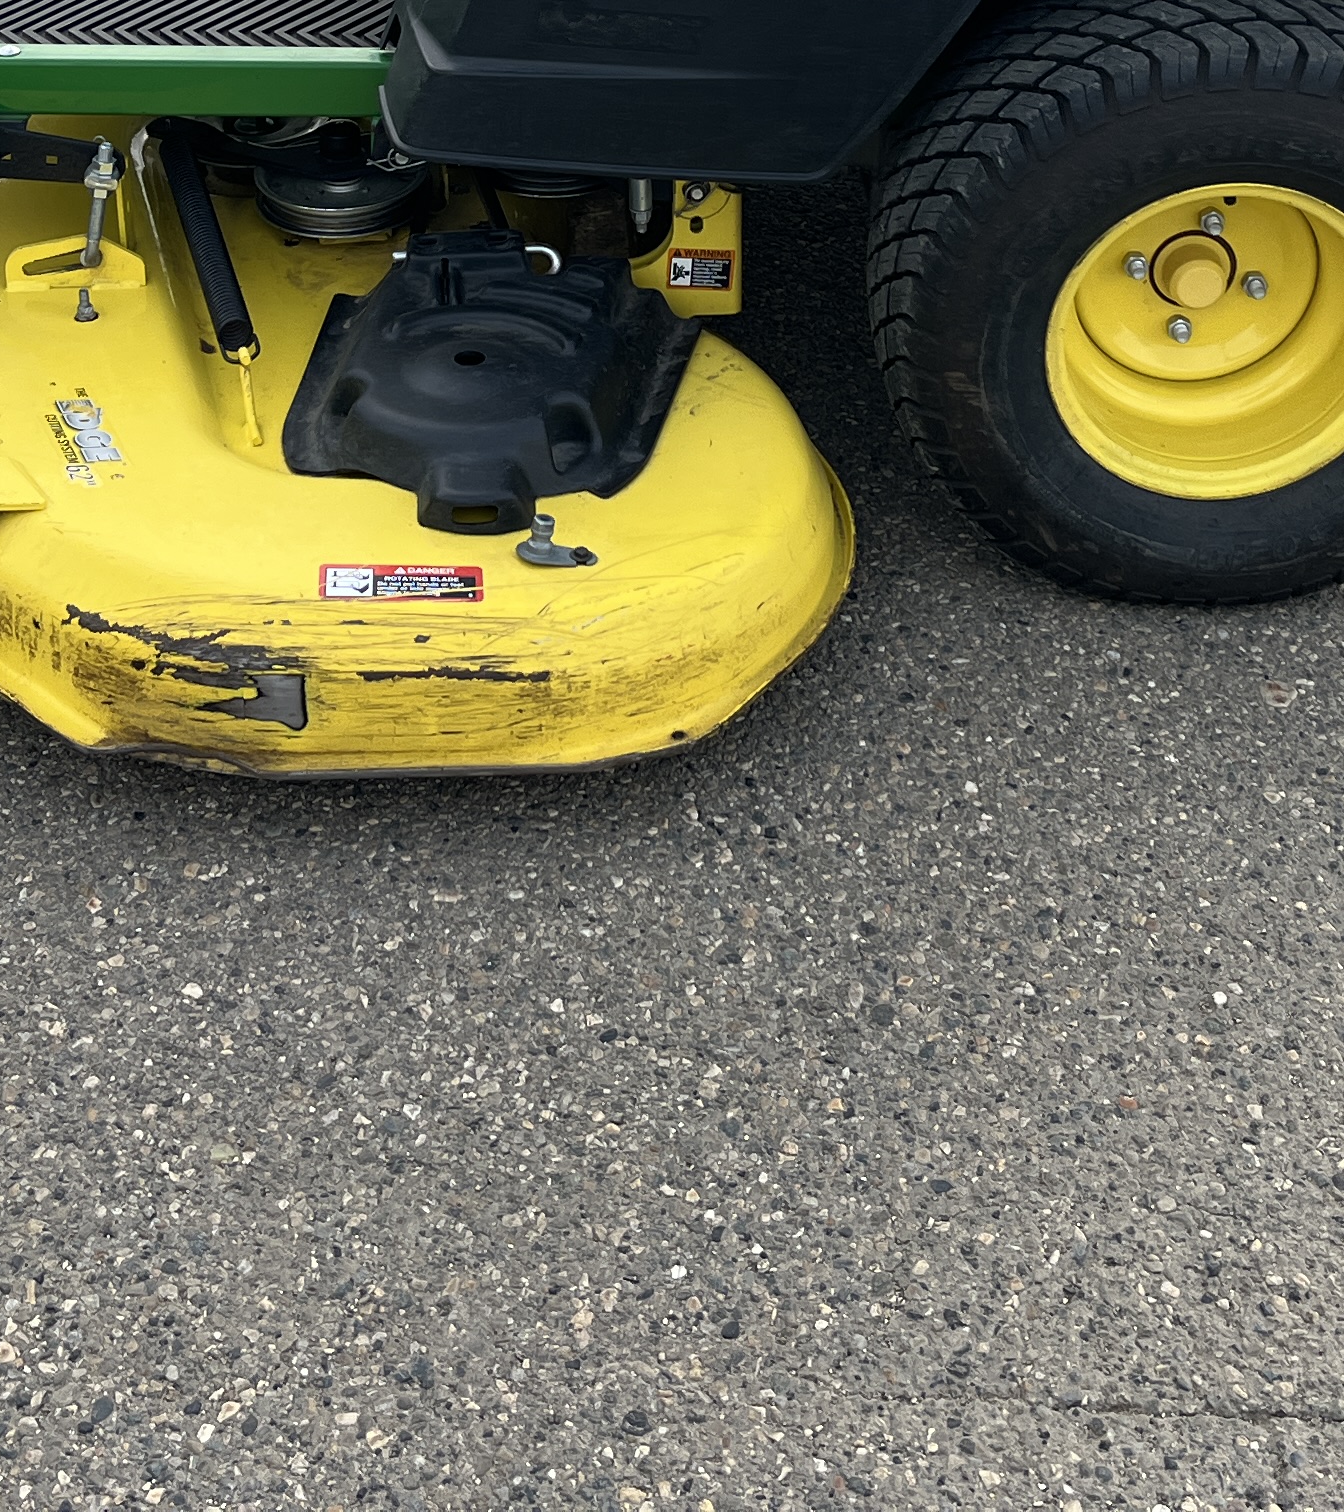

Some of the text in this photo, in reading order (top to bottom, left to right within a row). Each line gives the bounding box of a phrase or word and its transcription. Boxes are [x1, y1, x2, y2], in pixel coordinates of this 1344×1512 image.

[684, 250, 731, 258] WARNING
[74, 387, 89, 398] THE
[44, 414, 67, 439] CUTTING
[58, 439, 80, 464] SYSTEM
[407, 567, 456, 575] DANGER
